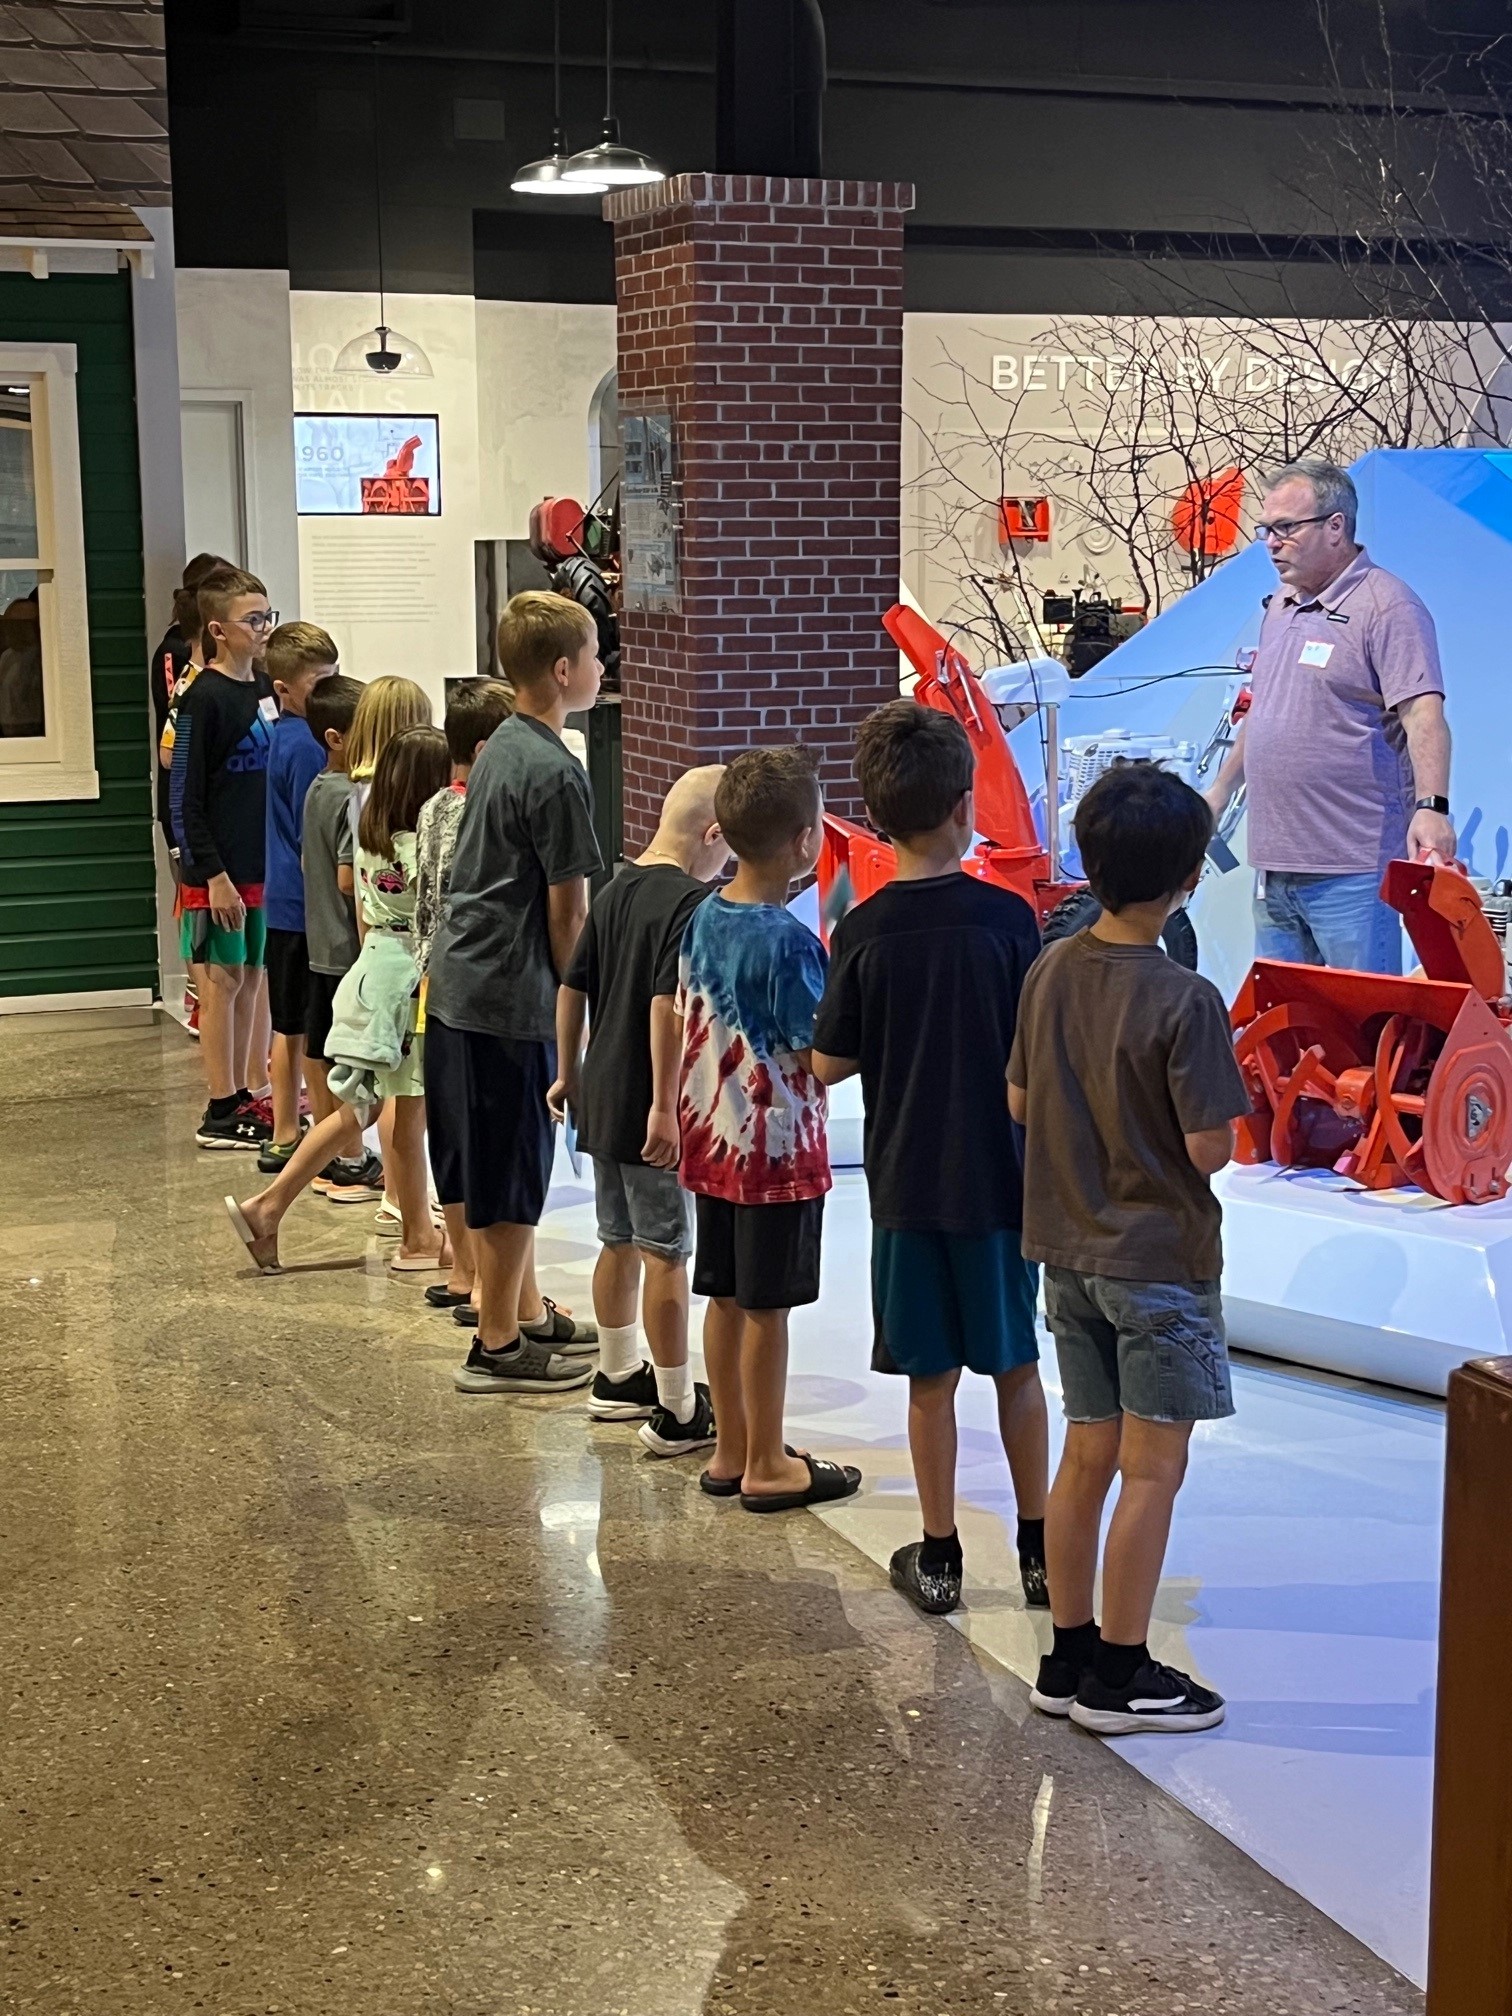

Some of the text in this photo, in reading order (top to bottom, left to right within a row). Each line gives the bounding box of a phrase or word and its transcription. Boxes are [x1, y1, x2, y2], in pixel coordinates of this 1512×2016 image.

[991, 354, 1400, 393] BETTER BY DESIGN
[296, 446, 344, 462] 960
